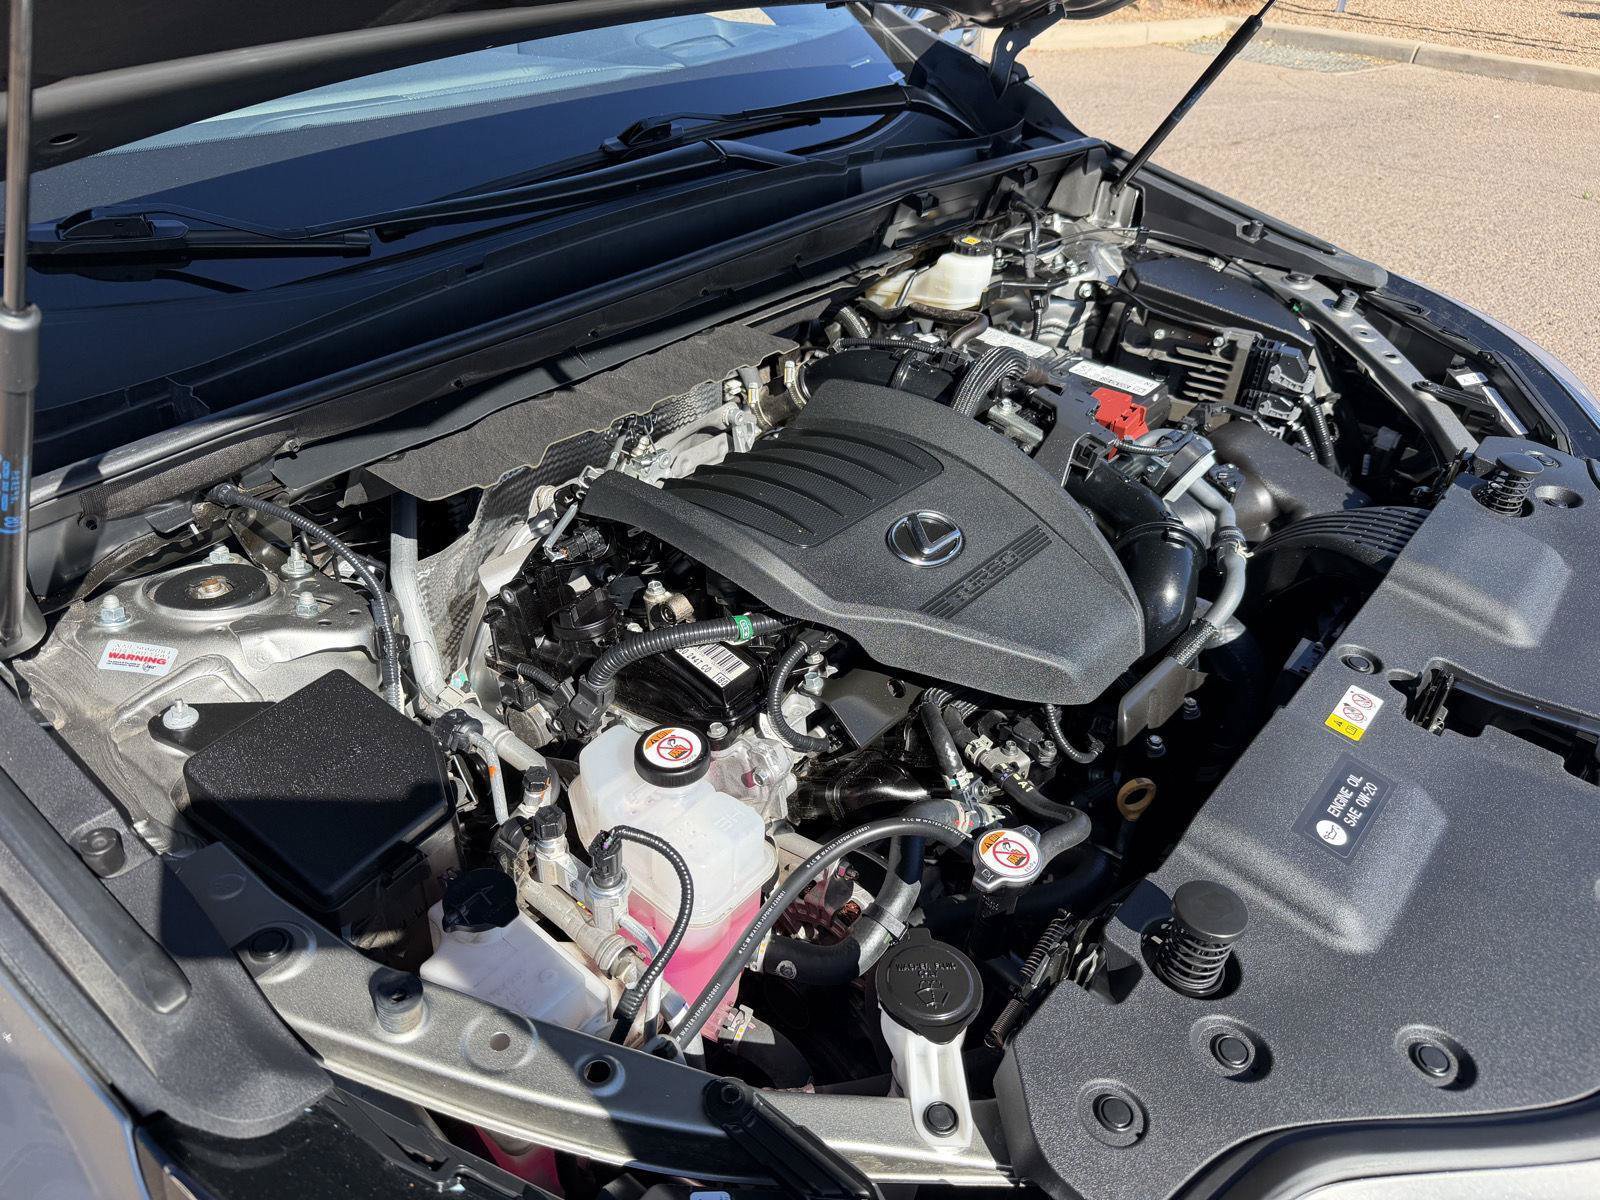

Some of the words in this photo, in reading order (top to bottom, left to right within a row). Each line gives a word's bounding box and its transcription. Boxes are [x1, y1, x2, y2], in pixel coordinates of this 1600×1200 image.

[945, 550, 1018, 604] TURBO
[108, 651, 168, 666] WARNING
[1326, 786, 1354, 818] ENGINE
[1346, 774, 1364, 788] OIL
[1343, 806, 1363, 828] SAE
[1355, 782, 1378, 808] 0W-20
